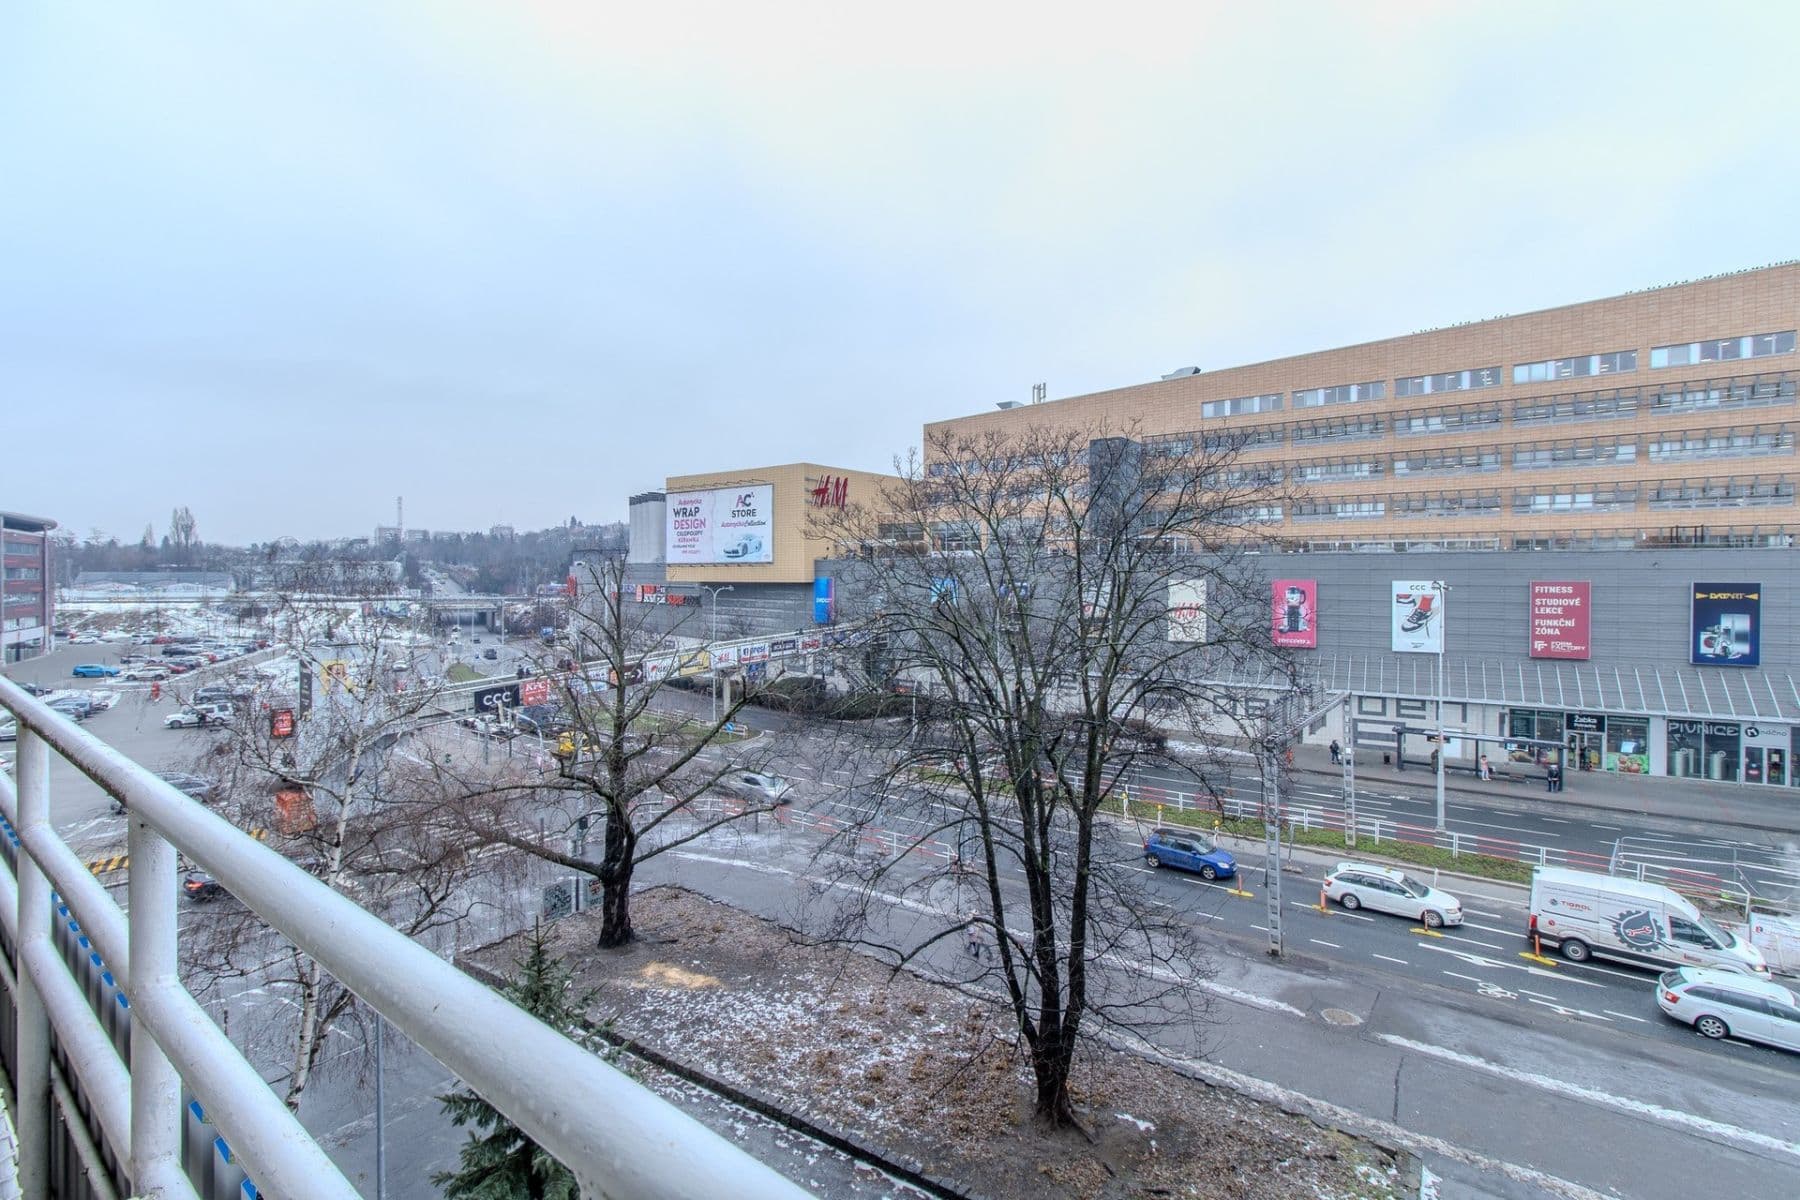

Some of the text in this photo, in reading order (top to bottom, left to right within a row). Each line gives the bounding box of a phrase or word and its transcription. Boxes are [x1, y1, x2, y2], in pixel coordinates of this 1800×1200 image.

[673, 507, 700, 518] WRAP
[731, 509, 757, 518] STORE
[674, 518, 706, 530] DESIGN
[1535, 597, 1581, 606] STUDIOVÉ
[1535, 618, 1575, 627] FUNKČNÍ
[1535, 627, 1560, 635] ZÓNA
[525, 681, 546, 692] KFC
[483, 692, 512, 706] CCC
[1574, 715, 1598, 723] Žabka
[1668, 722, 1740, 736] PIVNICE
